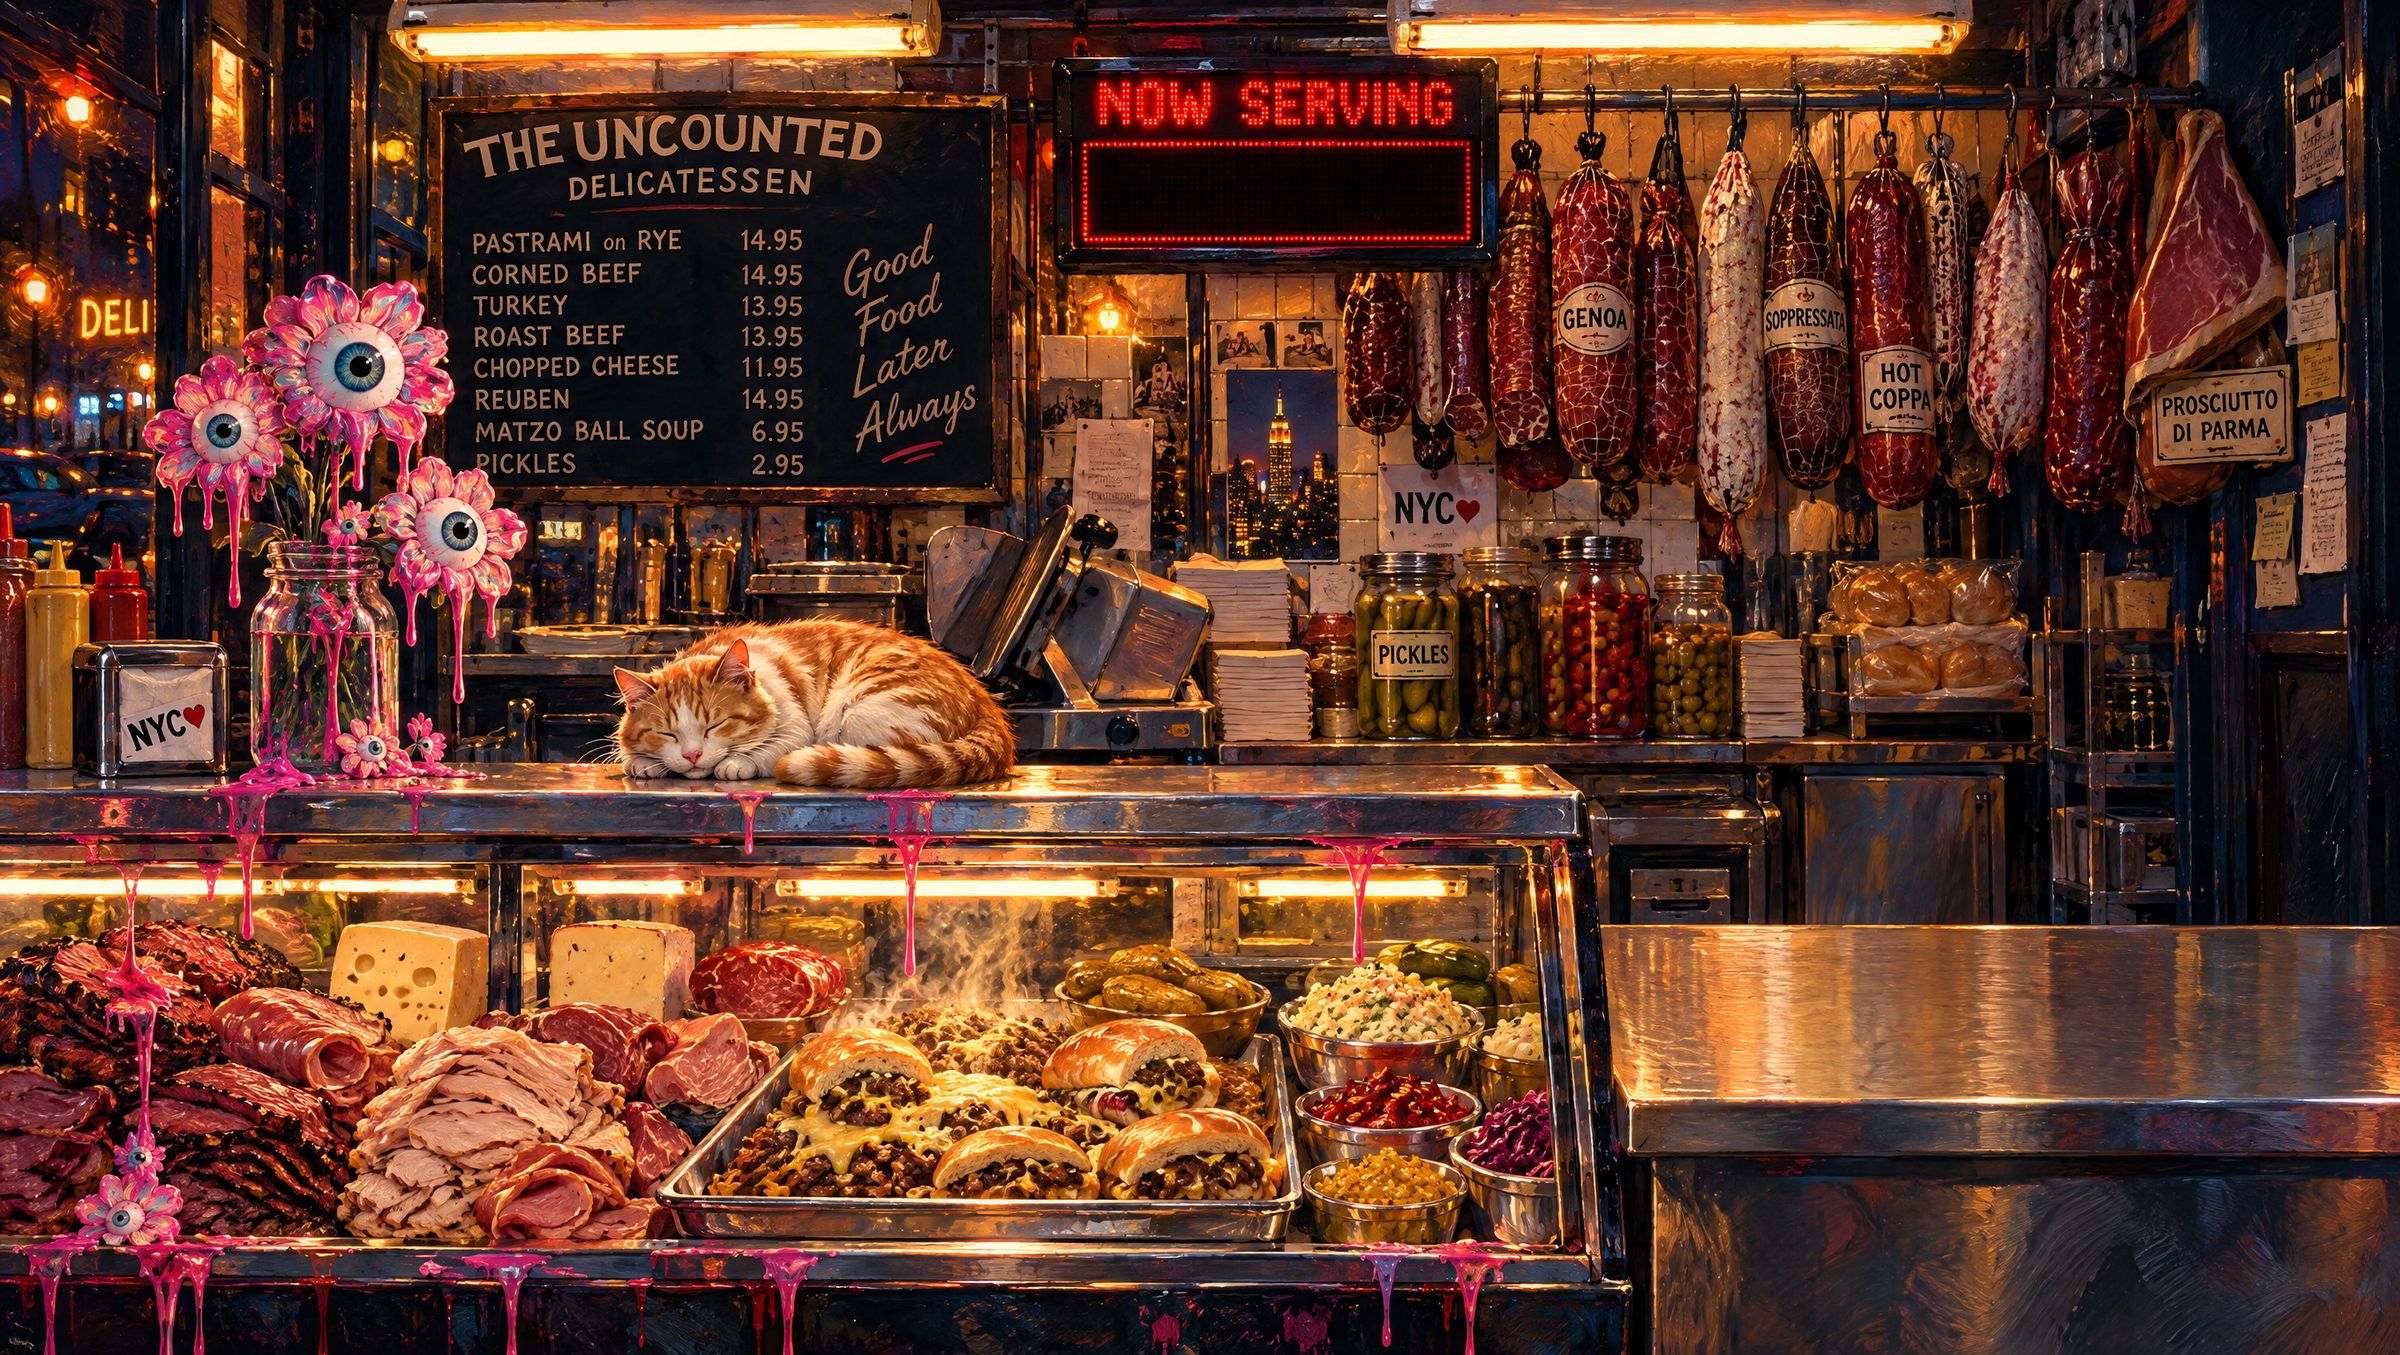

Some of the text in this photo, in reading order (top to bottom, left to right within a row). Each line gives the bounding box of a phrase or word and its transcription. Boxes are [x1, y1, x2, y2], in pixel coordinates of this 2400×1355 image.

[1099, 81, 1453, 126] NOW SERVING
[463, 114, 883, 178] THE UNCOUNTED
[569, 167, 812, 201] DELICATESSEN
[473, 229, 802, 254] PASTRAMI on RYE 14.95
[844, 224, 933, 298] Good
[473, 263, 802, 285] CORNED BEEF 14.95
[473, 295, 802, 316] TURKEY 13.95
[855, 272, 942, 347] Food
[81, 299, 149, 339] DELI
[1563, 307, 1628, 330] GENOA
[1766, 308, 1846, 332] SOPPRESSATA
[475, 325, 802, 347] ROAST BEEF 13.95
[474, 355, 802, 378] CHOPPED CHEESE 11.95
[853, 338, 953, 398] Later
[1881, 363, 1921, 383] HOT
[476, 389, 803, 410] REUBEN 14.95
[1870, 388, 1931, 411] COPPA
[2163, 389, 2278, 417] PROSCIUTTO
[476, 420, 803, 442] MATZO BALL SOUP 6.95
[856, 385, 975, 453] Always
[2173, 418, 2271, 443] DI PARMA
[476, 453, 803, 475] PICKLES 2.95
[1395, 492, 1455, 524] NYC
[1379, 645, 1449, 664] PICKLES
[127, 709, 186, 752] NYC
